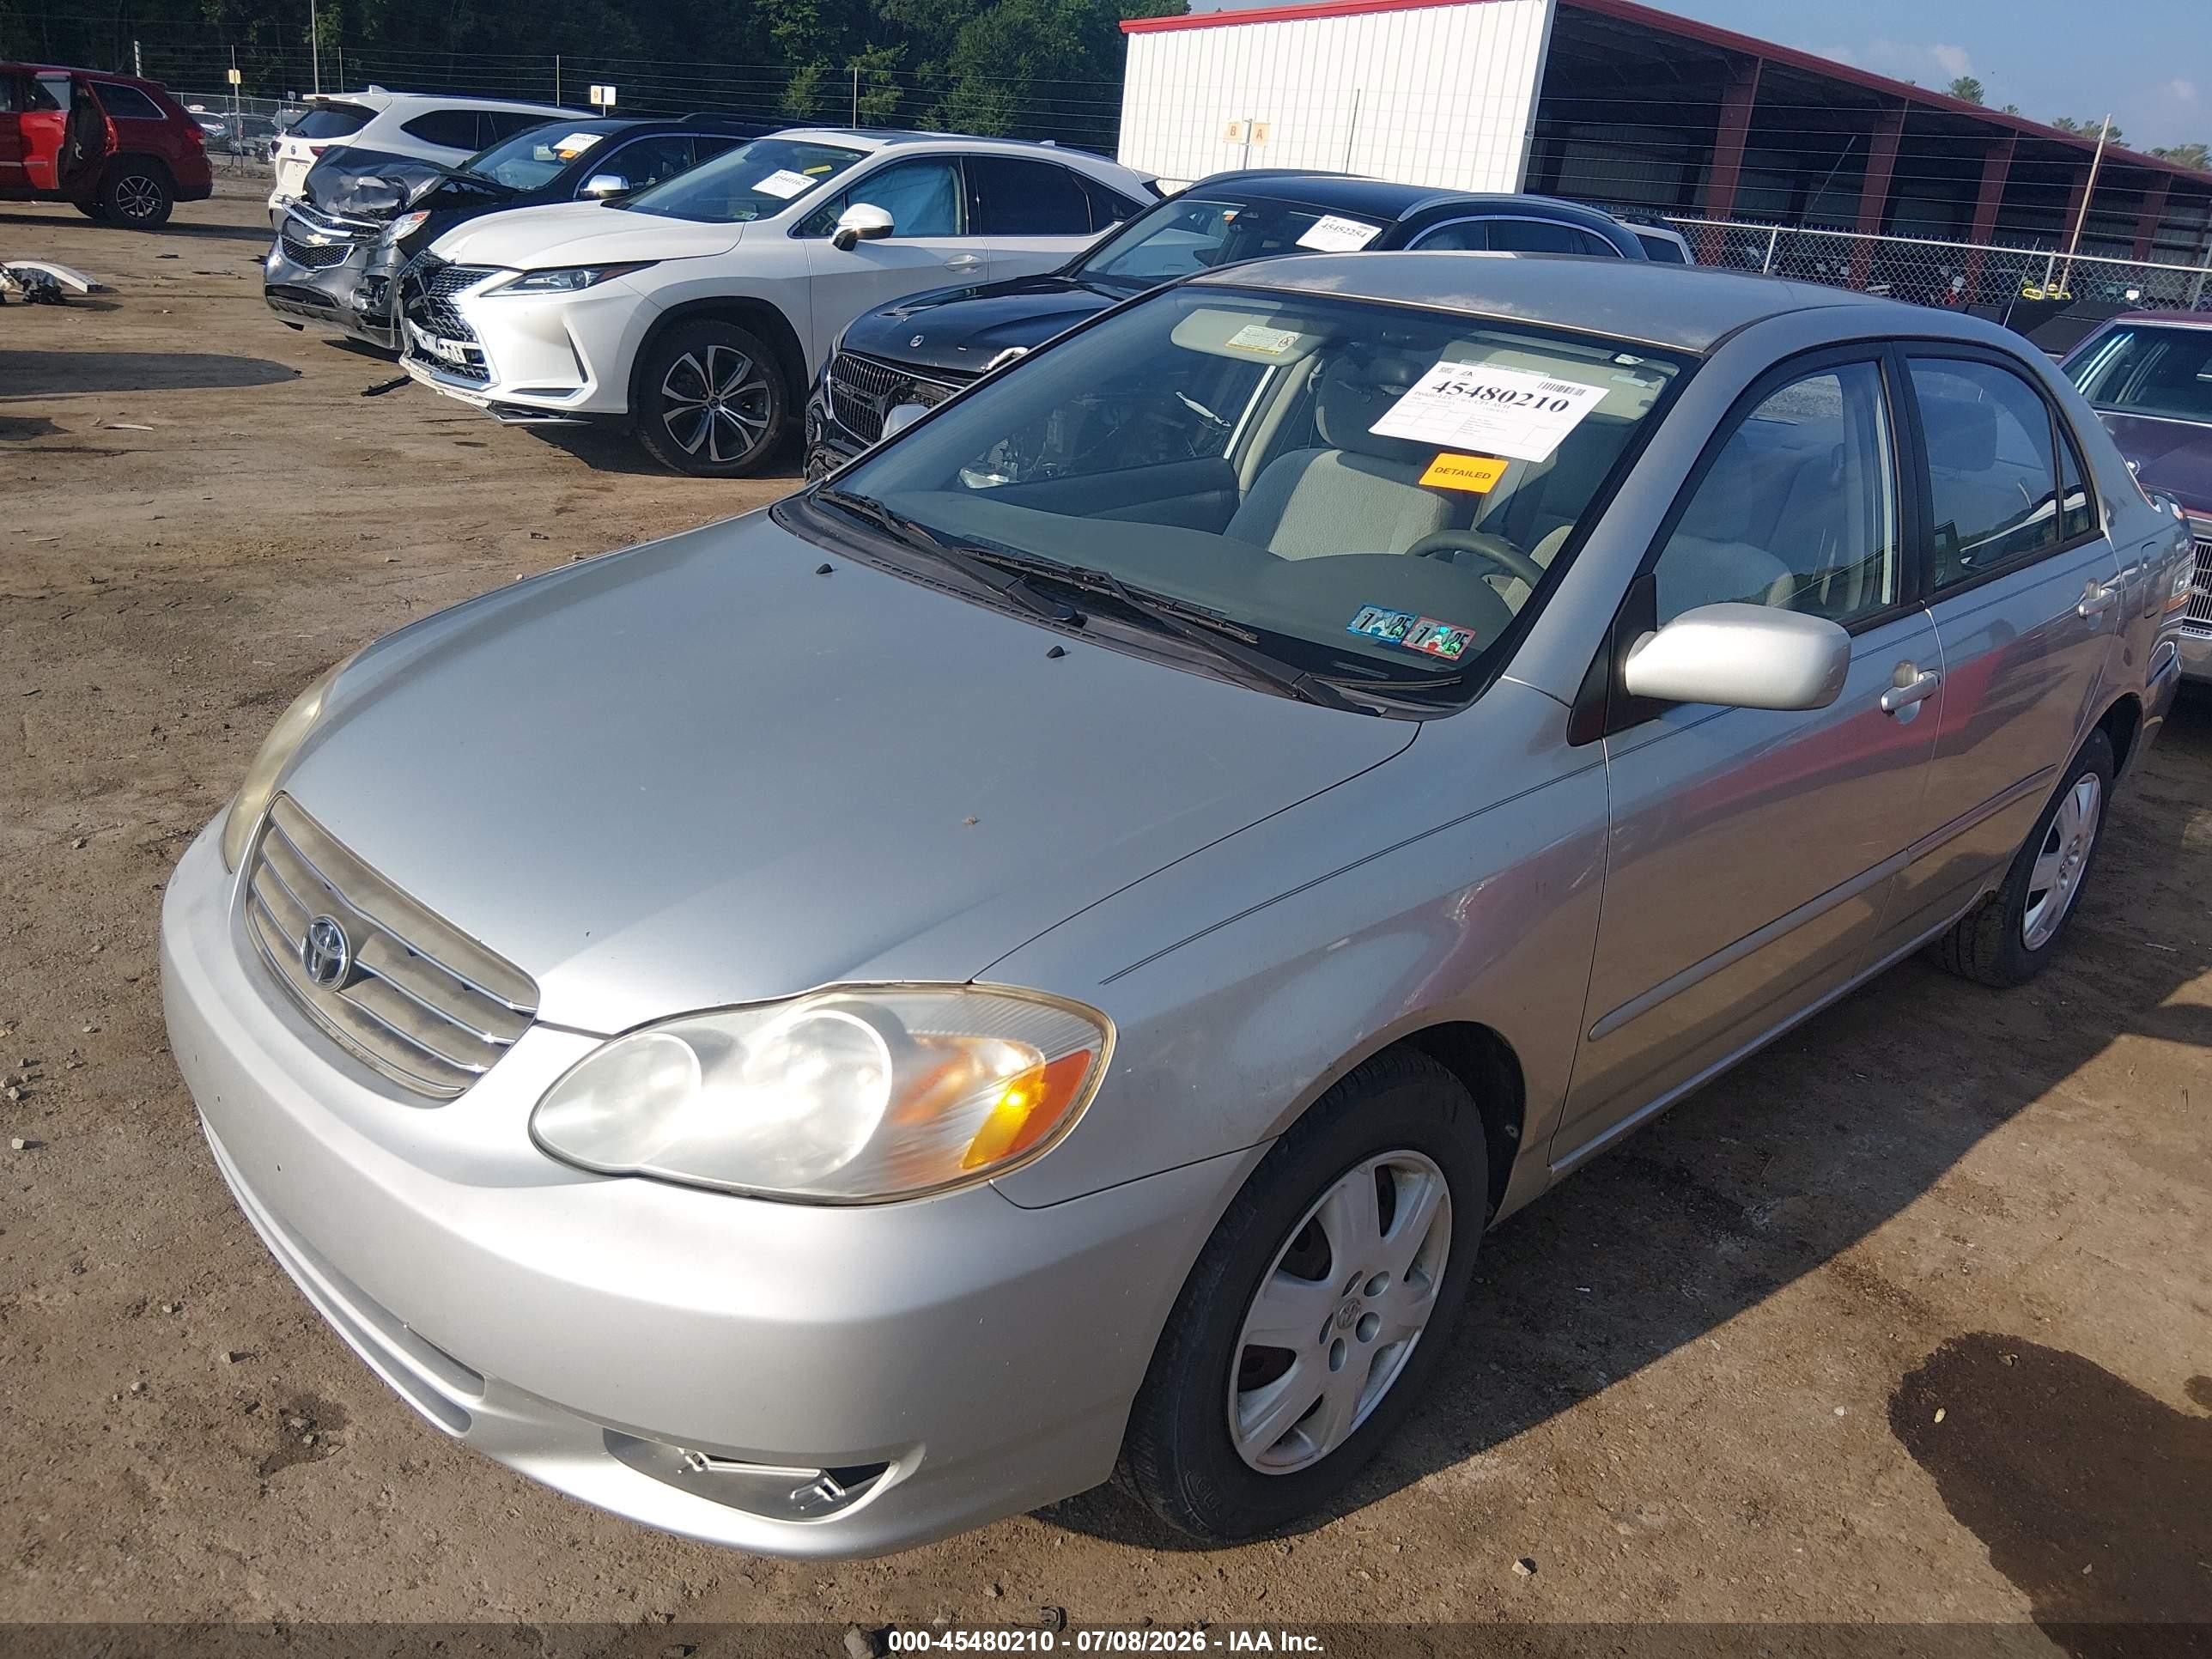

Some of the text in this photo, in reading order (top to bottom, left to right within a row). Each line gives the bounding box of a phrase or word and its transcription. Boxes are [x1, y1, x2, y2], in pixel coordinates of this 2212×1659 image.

[1230, 125, 1237, 137] B
[1256, 129, 1263, 139] A
[1431, 380, 1570, 413] 45480210
[1434, 466, 1492, 479] DETAILED
